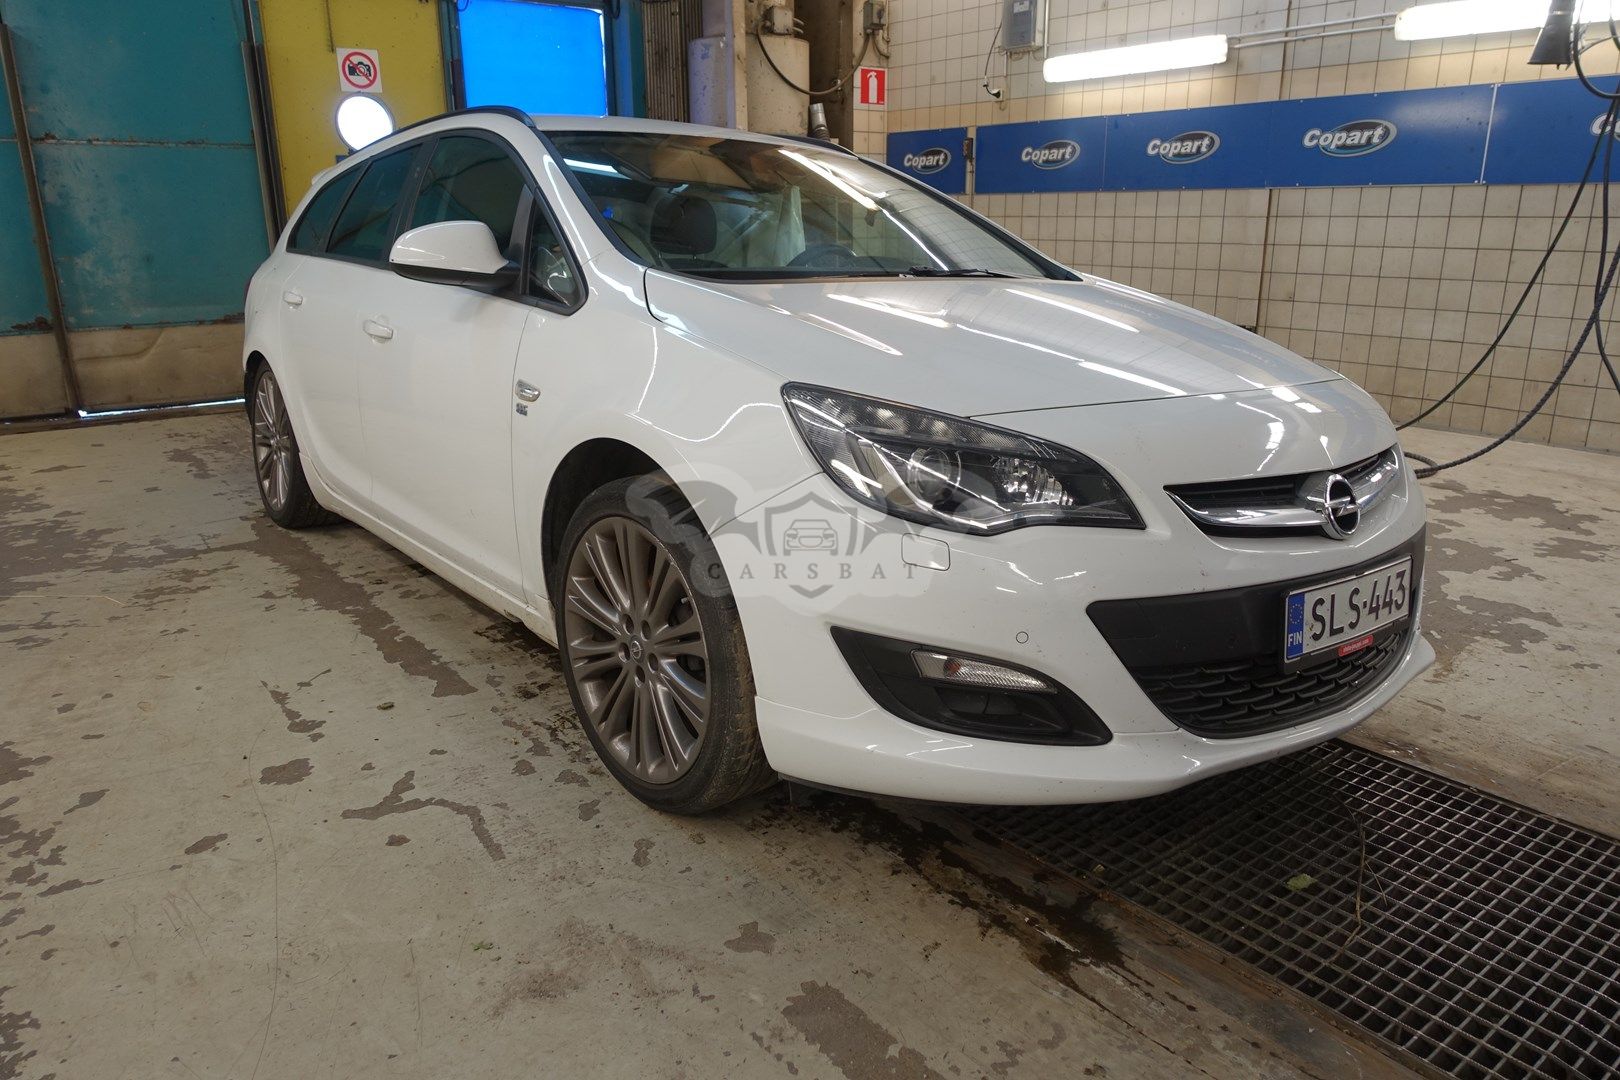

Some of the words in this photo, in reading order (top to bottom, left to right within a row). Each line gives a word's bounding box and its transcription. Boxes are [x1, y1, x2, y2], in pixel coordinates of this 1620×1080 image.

[1303, 124, 1384, 149] Copart
[1021, 147, 1073, 163] Copart
[1147, 139, 1211, 157] Copart
[904, 153, 945, 168] Copart
[1312, 570, 1406, 641] SLS-443
[1288, 631, 1303, 647] FIN
